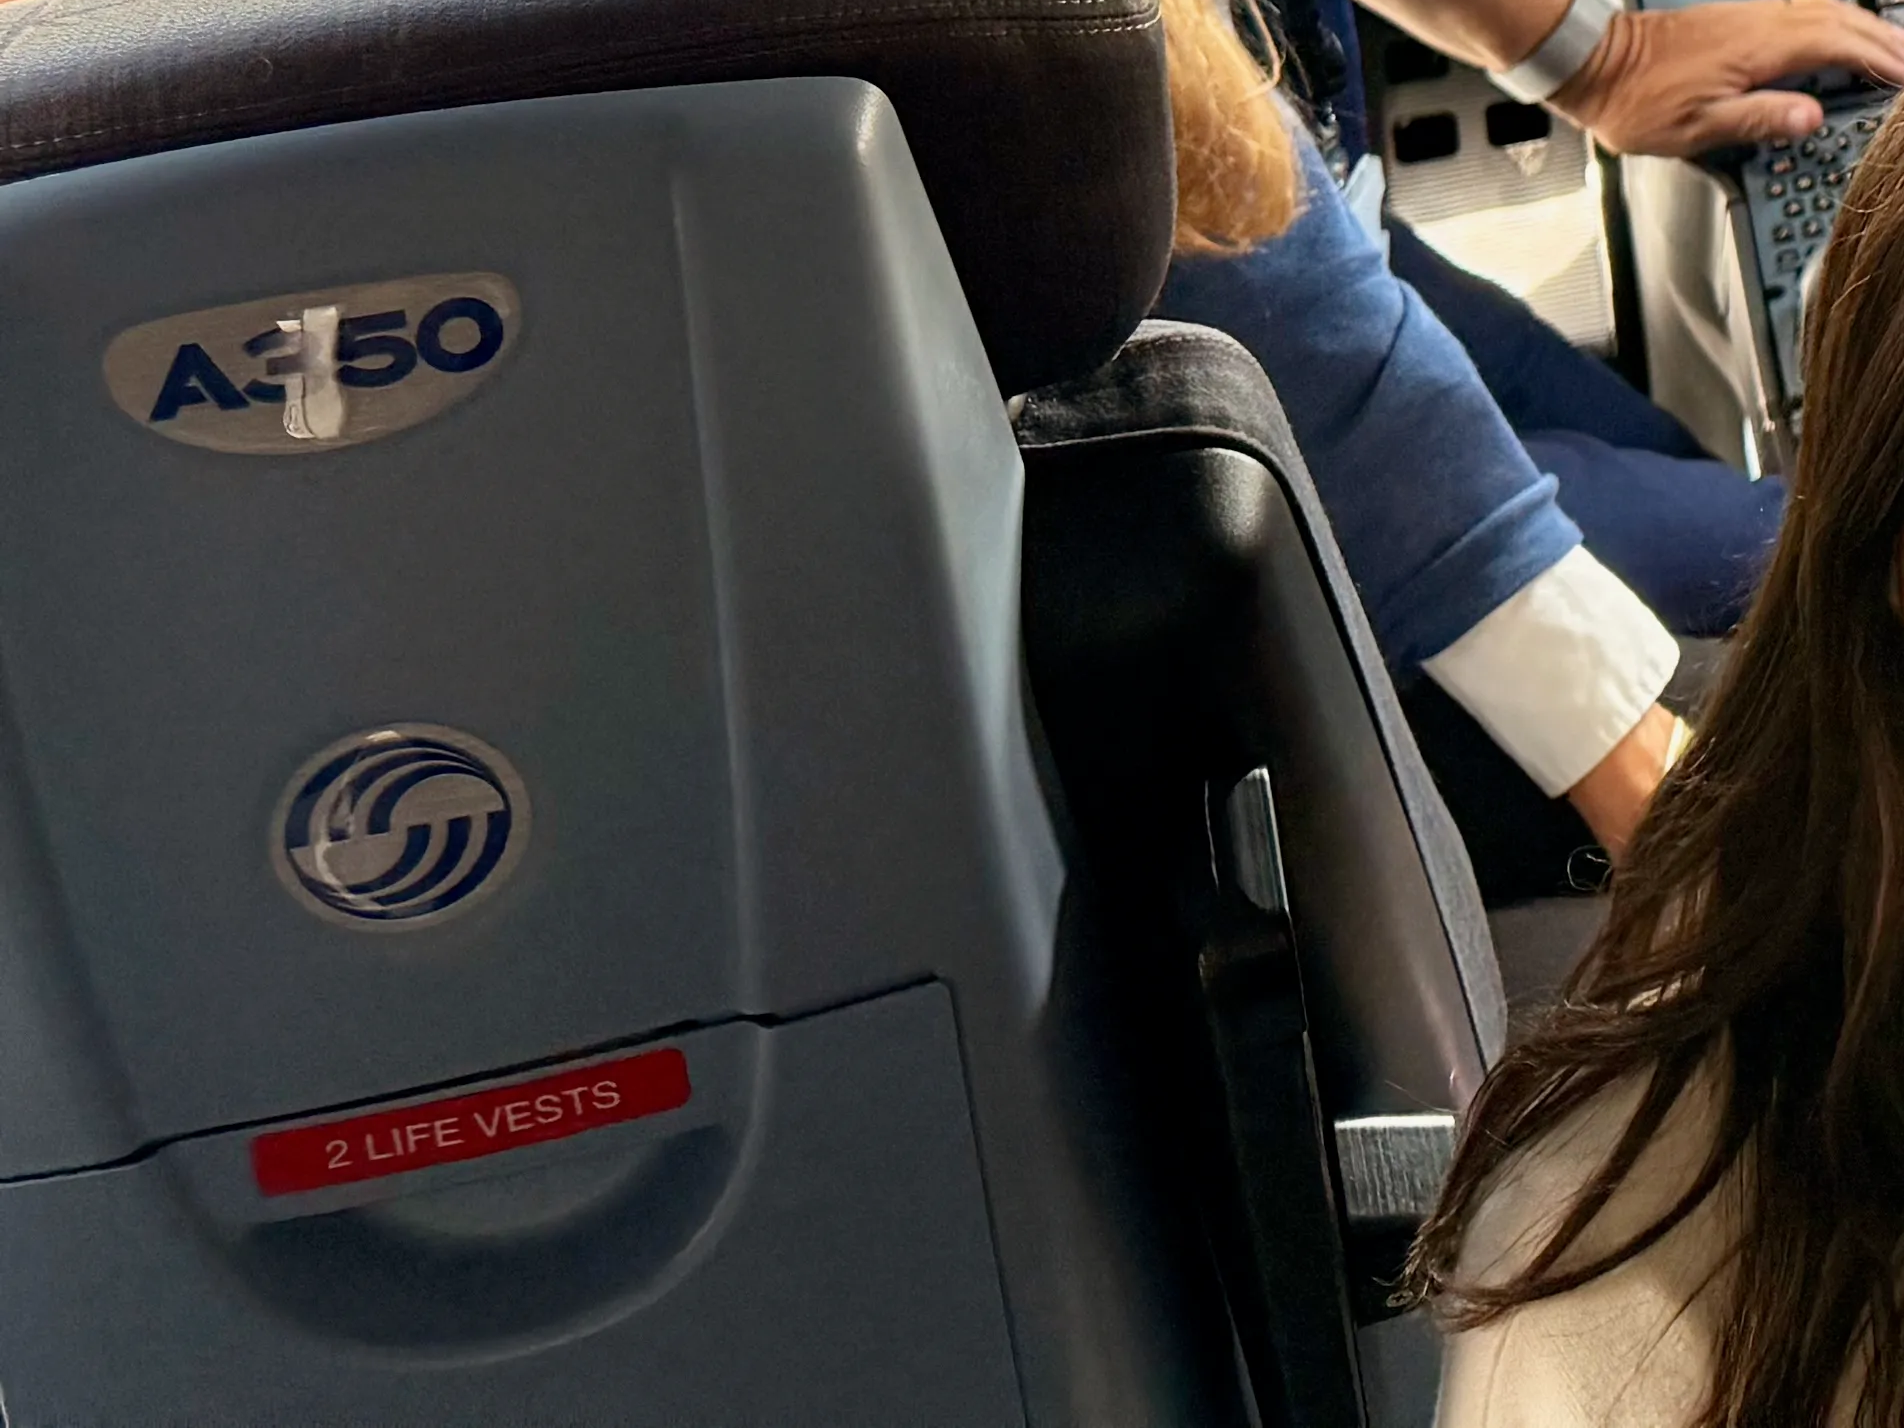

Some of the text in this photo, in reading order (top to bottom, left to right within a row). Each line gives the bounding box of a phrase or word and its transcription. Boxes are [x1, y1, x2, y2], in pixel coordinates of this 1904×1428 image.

[149, 296, 504, 423] A350
[326, 1080, 622, 1170] 2 LIFE VESTS
